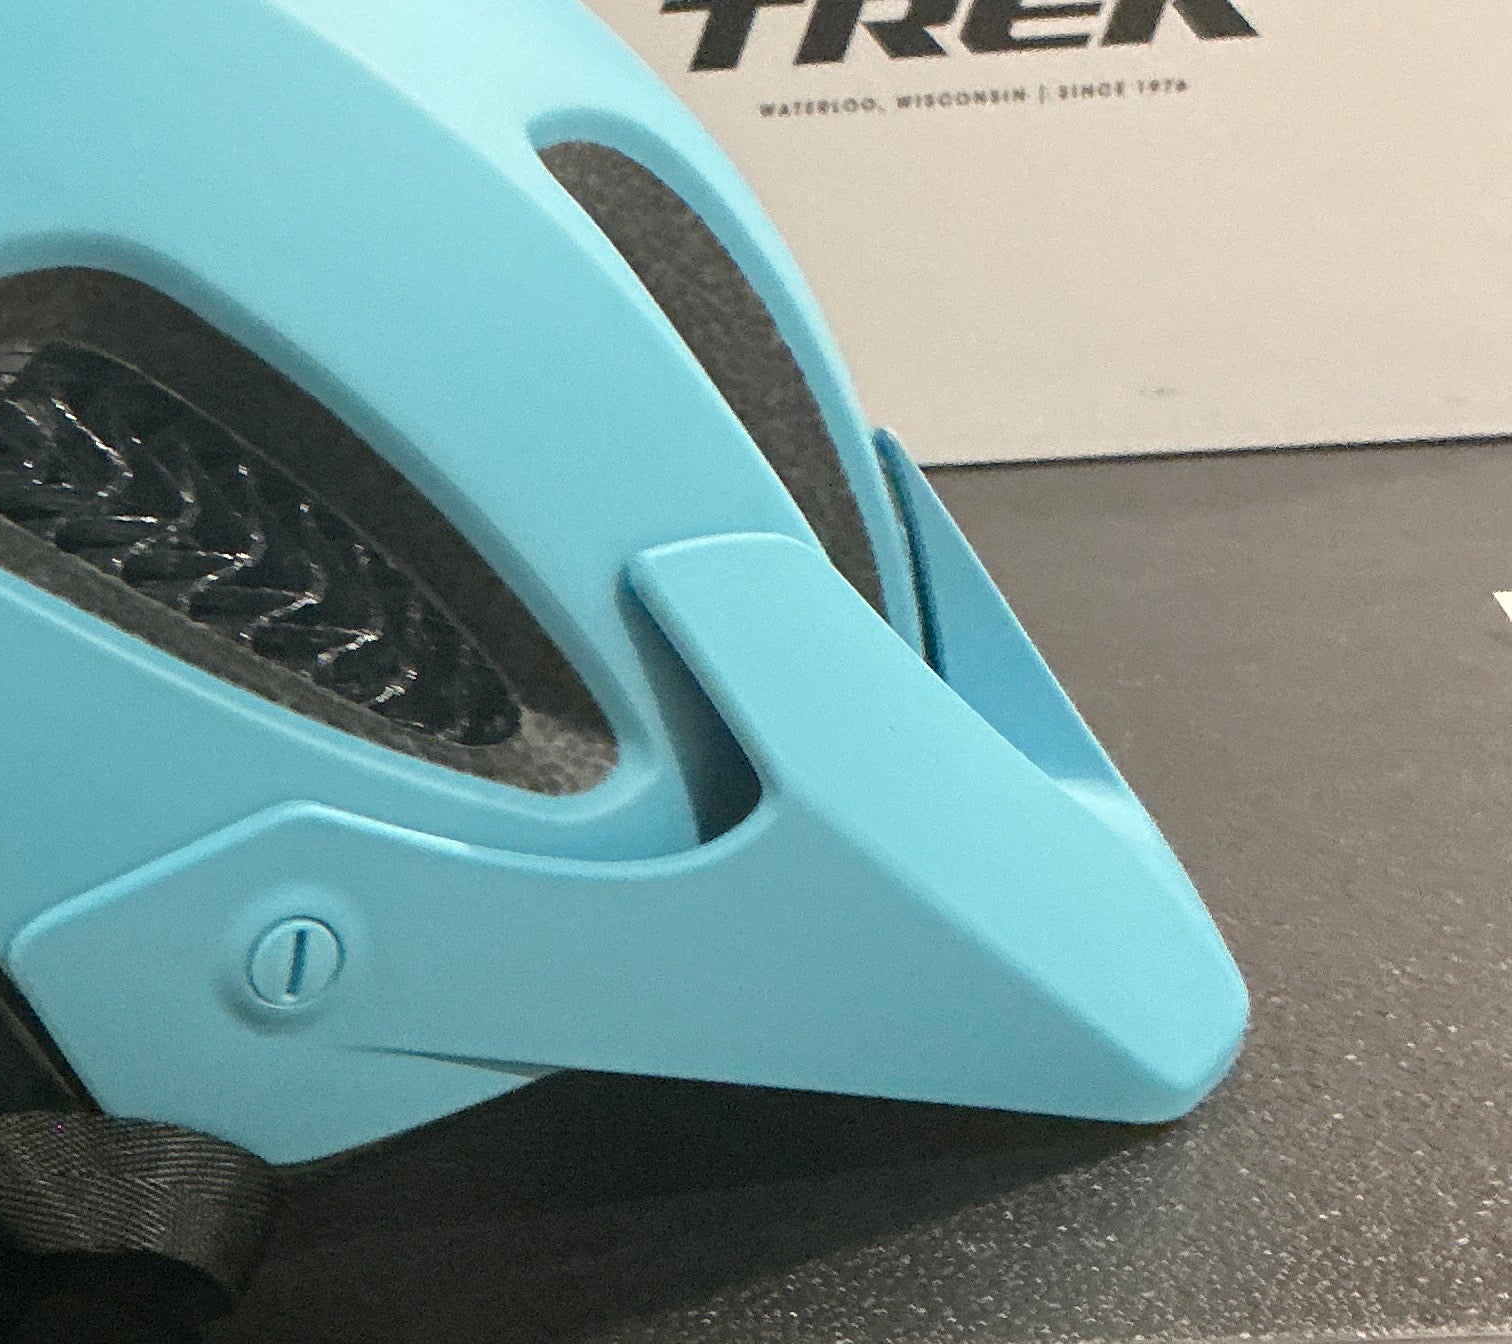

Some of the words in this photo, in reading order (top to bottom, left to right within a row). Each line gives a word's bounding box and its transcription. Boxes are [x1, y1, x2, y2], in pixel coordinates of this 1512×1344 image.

[759, 97, 886, 117] WATERLOO,
[896, 88, 1027, 109] WISCONSIN
[1058, 80, 1125, 101] SINCE
[1137, 78, 1188, 94] 1976
